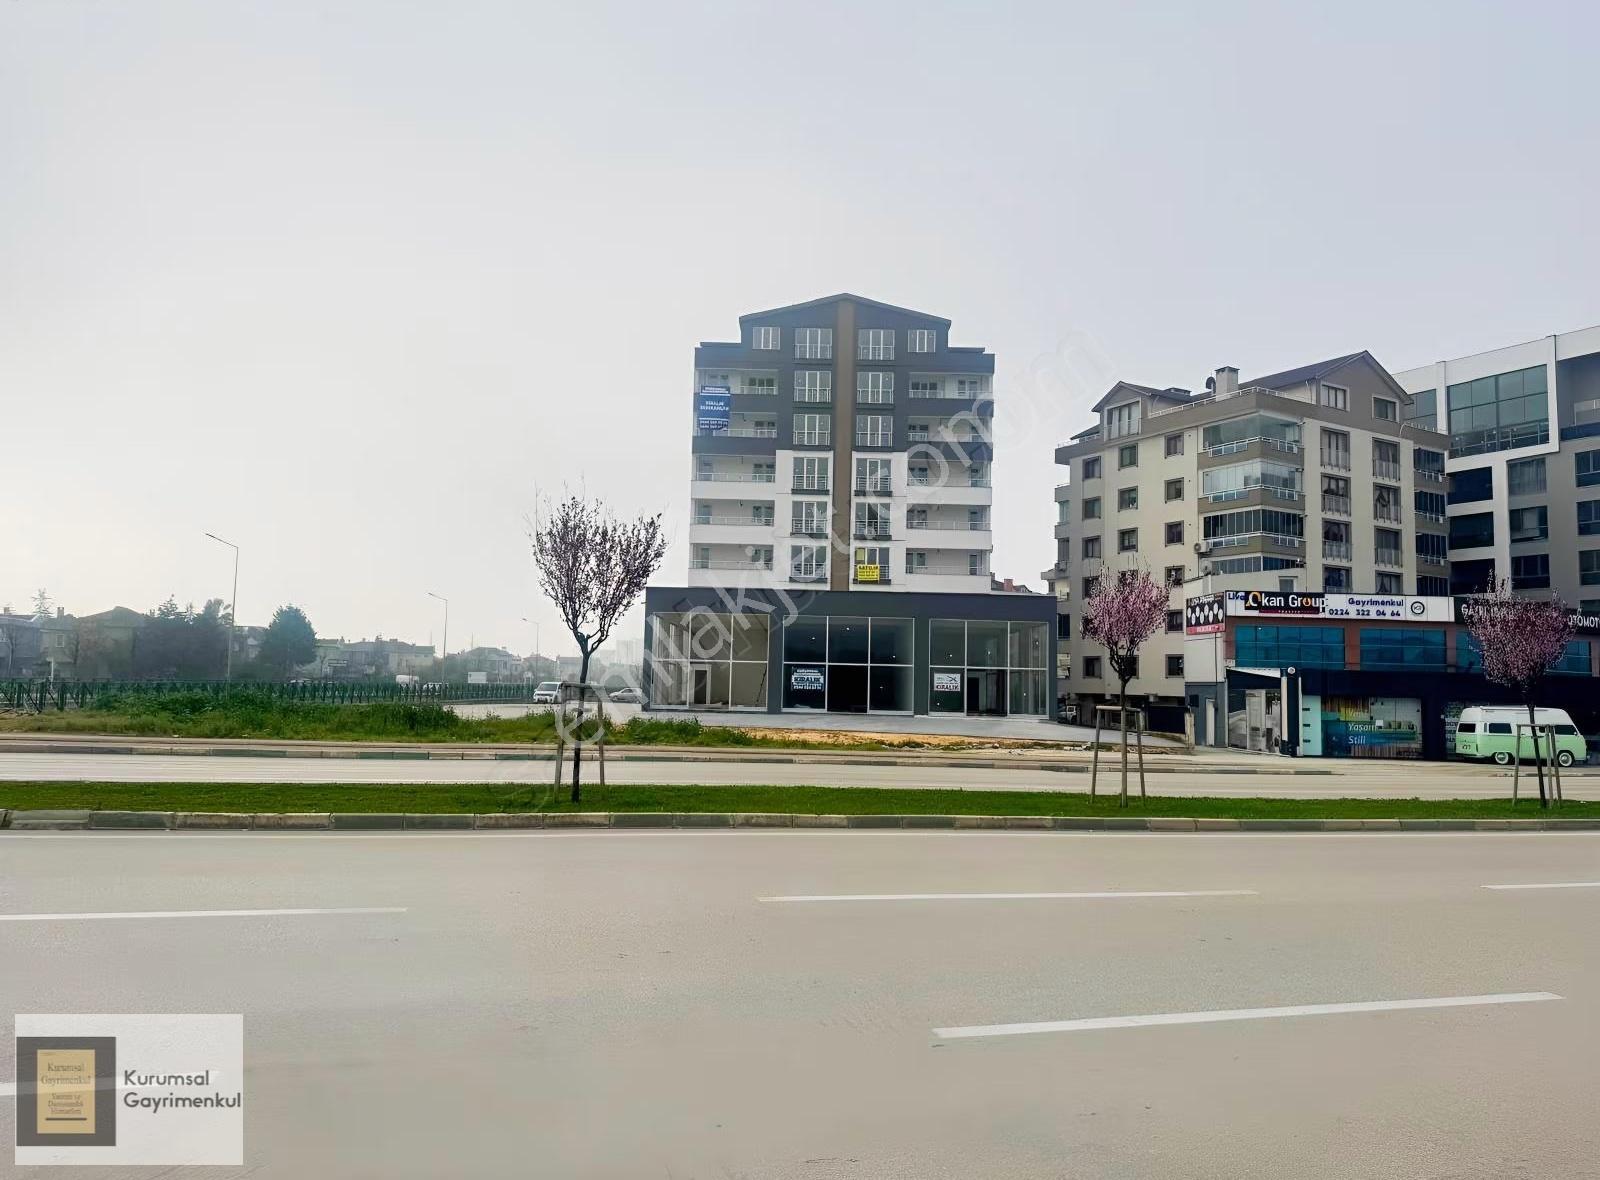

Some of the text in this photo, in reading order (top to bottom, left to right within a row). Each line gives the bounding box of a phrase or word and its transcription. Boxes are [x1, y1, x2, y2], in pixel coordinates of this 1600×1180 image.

[1288, 593, 1327, 614] Group
[1348, 597, 1404, 608] Gayrimenkul
[1328, 608, 1350, 616] 0224
[1355, 609, 1371, 617] 322
[1567, 615, 1600, 628] OTOMOT
